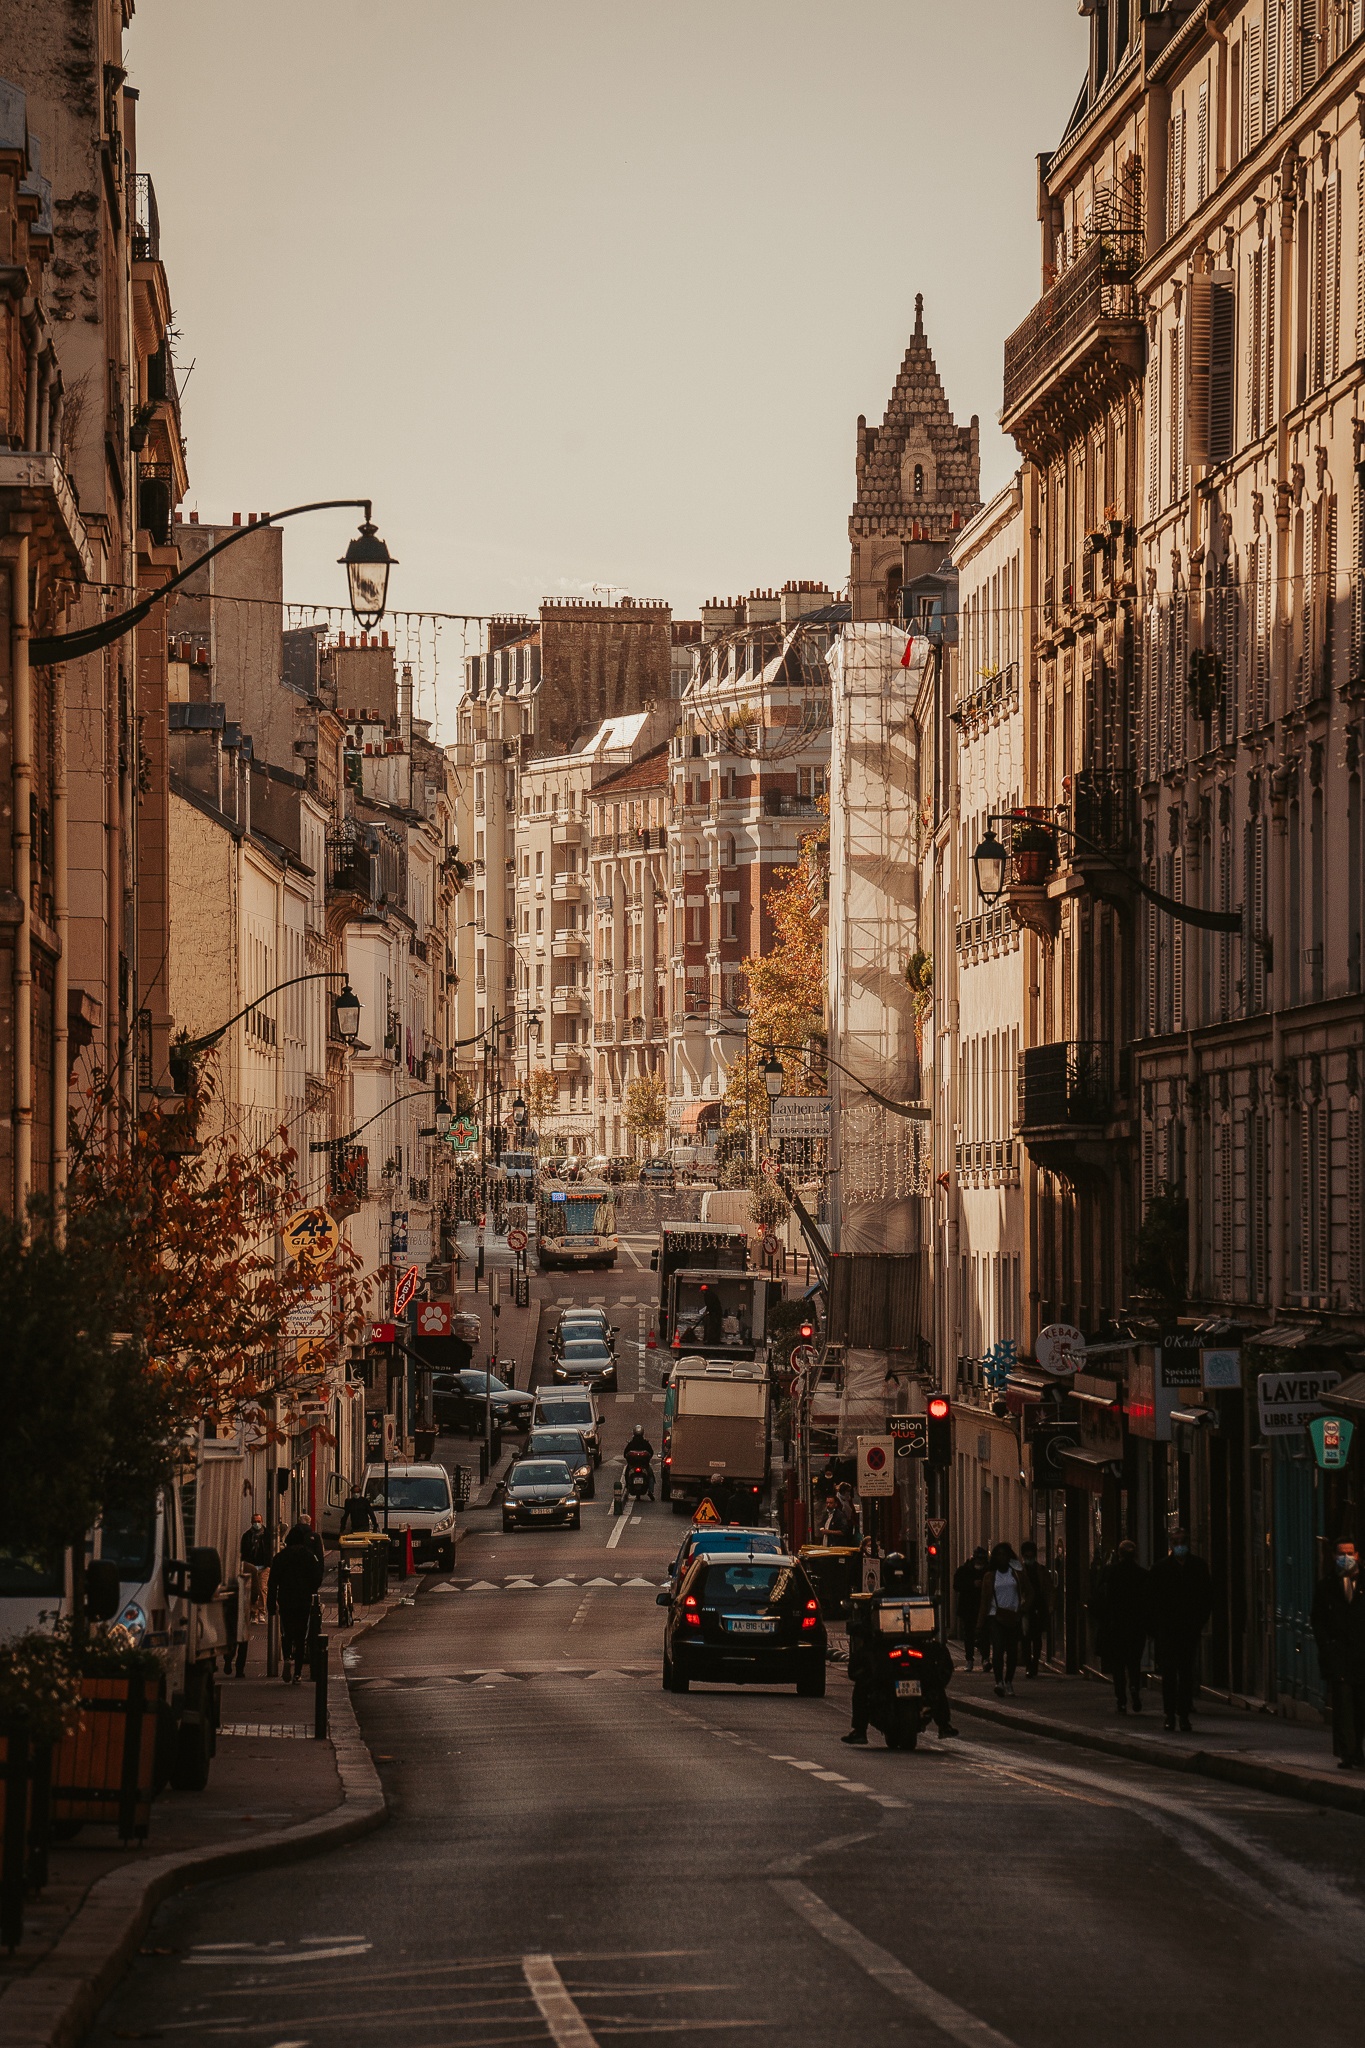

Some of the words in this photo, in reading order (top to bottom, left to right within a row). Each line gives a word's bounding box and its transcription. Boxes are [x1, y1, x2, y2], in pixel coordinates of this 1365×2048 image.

[398, 1272, 415, 1308] TABAC
[1044, 1328, 1079, 1340] KEBAB
[890, 1420, 922, 1430] vision
[1265, 1414, 1293, 1426] LIBRE
[1326, 1437, 1338, 1445] 86
